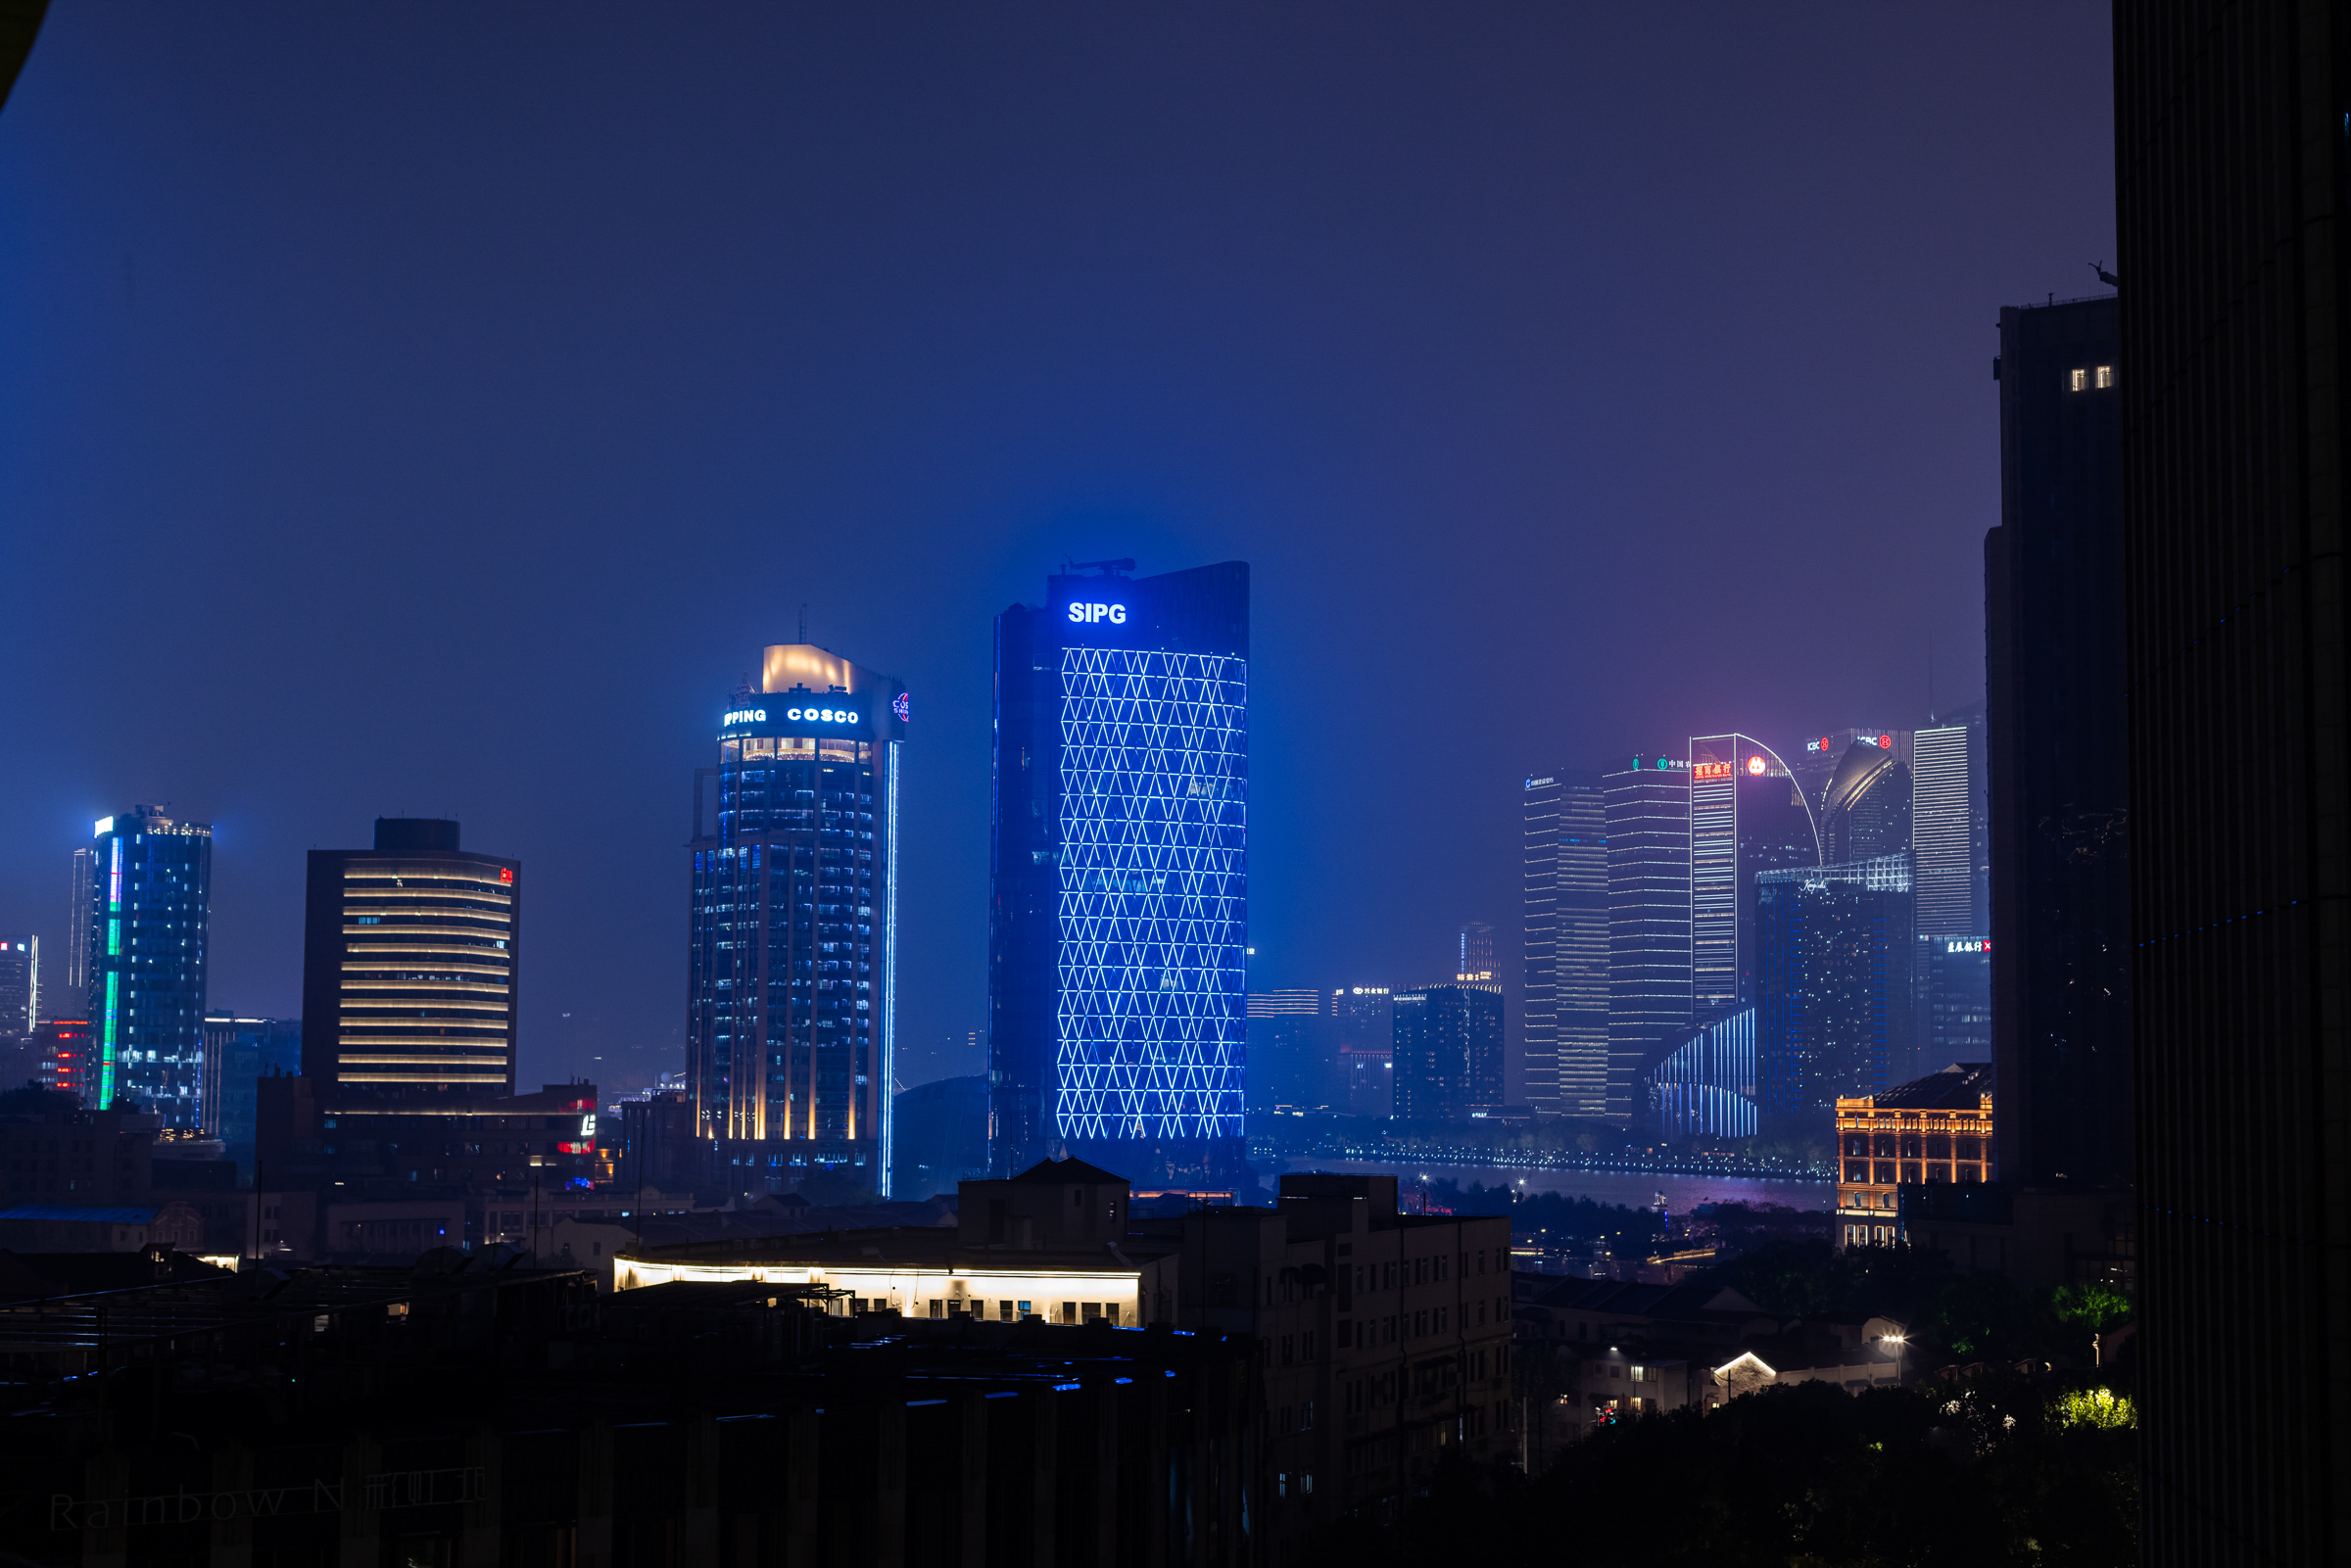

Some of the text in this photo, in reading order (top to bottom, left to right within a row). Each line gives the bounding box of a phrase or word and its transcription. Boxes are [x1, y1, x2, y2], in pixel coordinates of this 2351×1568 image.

[1069, 602, 1126, 624] SIPG
[787, 708, 858, 724] COSCO
[51, 1482, 285, 1532] Rainbow
